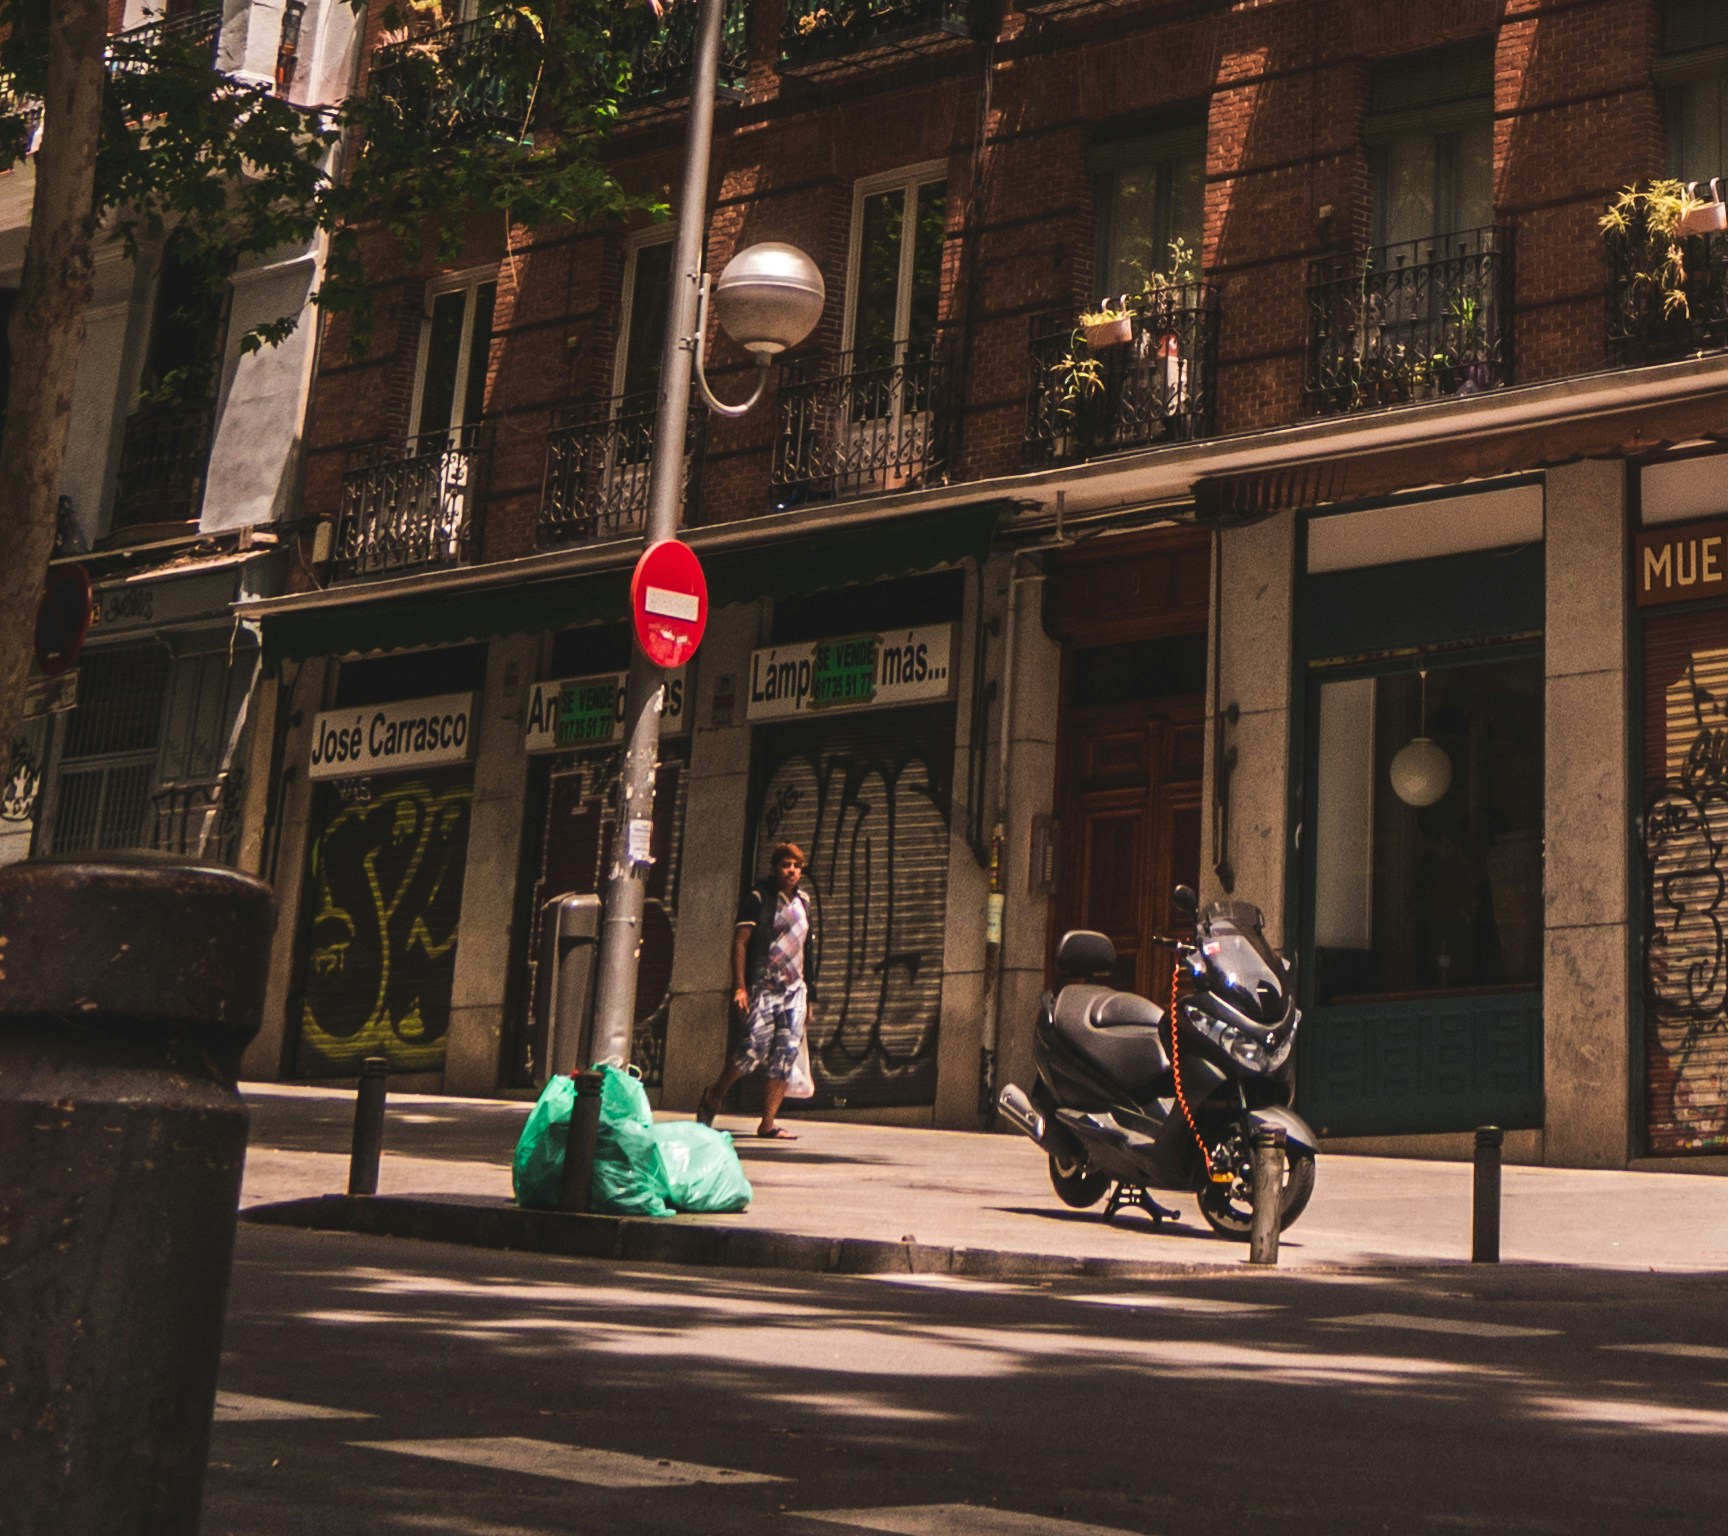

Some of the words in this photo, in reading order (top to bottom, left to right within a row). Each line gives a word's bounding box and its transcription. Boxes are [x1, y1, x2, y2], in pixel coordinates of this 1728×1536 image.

[817, 645, 831, 672] SE
[836, 640, 875, 669] VENDE
[562, 690, 575, 714] SE
[579, 685, 614, 712] VENDE
[751, 650, 811, 709] Lámp
[312, 715, 363, 766] José
[369, 712, 468, 758] Carrasco
